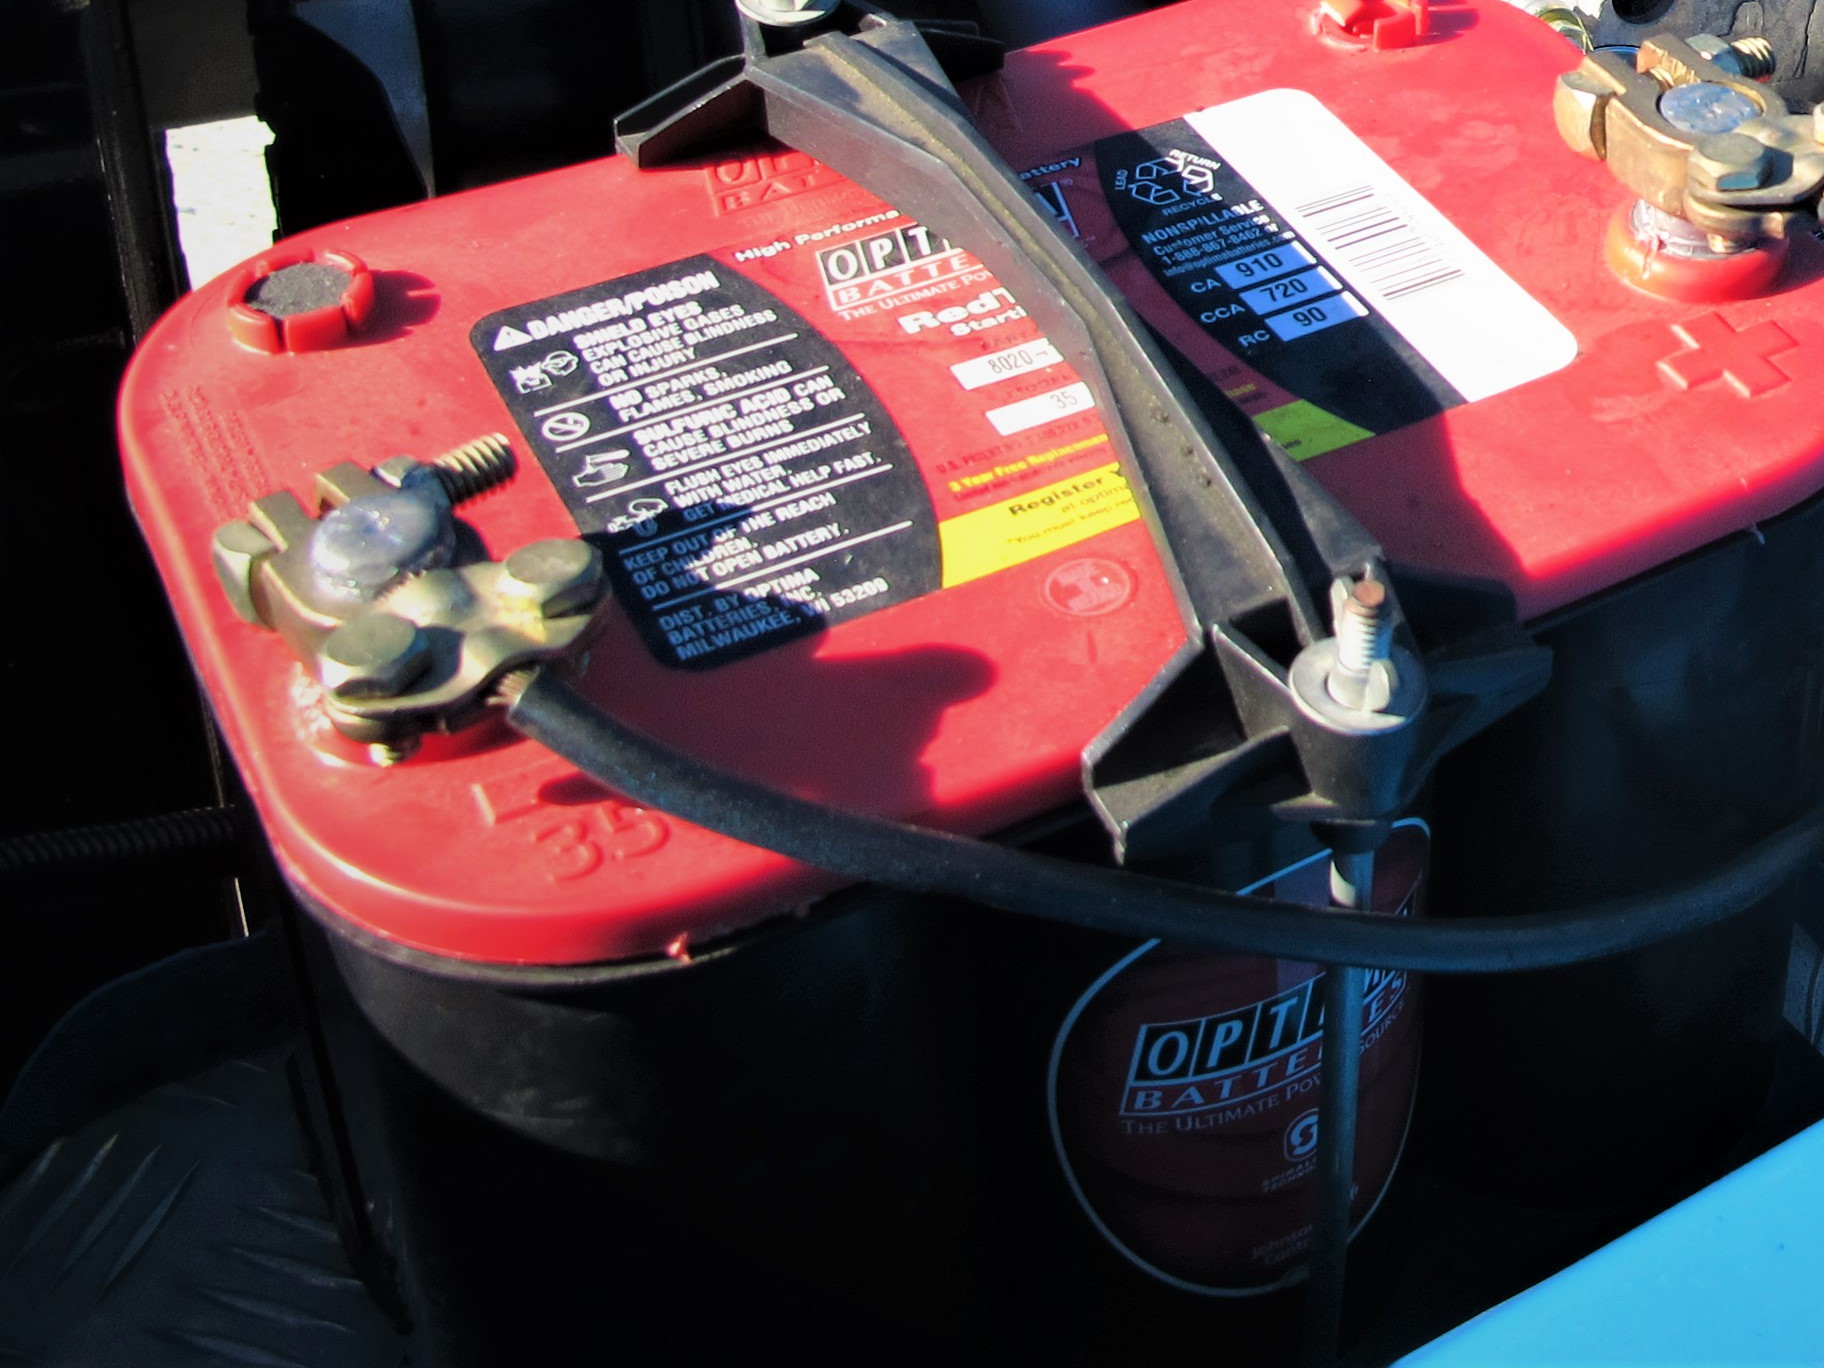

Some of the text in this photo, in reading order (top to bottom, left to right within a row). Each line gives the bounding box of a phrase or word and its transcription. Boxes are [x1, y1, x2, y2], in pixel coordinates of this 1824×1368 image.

[1020, 157, 1081, 180] attery
[1114, 169, 1128, 190] LEAD
[1168, 148, 1220, 170] RETURN
[1141, 199, 1264, 244] NONSPILLABLE
[1162, 193, 1223, 216] RECYCLE
[734, 209, 901, 263] High Performa
[827, 226, 934, 282] OPT
[1153, 214, 1271, 255] Customer Service
[838, 253, 971, 304] BATTE
[1190, 252, 1284, 294] CA 910
[526, 271, 720, 340] DANGER/POISON
[950, 305, 1027, 336] Starti
[1199, 278, 1309, 324] CCA 720
[572, 301, 703, 349] SHIELD EYES
[580, 304, 746, 362] EXPLOSIVE GASES
[589, 308, 778, 375] CAN CAUSE BLINDNESS
[1238, 306, 1328, 348] RC 90
[597, 347, 696, 387] OR INJURY
[702, 360, 793, 397] SMOKING
[608, 388, 643, 411] NO
[632, 374, 835, 445] SULFURIC ACID CAN
[1050, 391, 1078, 409] 35
[641, 387, 846, 458] CAUSE BLINDNESS OR
[651, 419, 794, 472] SEVERE BURNS
[663, 421, 872, 496] FLUSH EYES IMMEDIATELY
[673, 485, 721, 509] WITH
[684, 449, 882, 523] GET MEDICAL HELP FAST.
[1008, 477, 1103, 516] Register
[623, 492, 838, 572] KEEP OUT OF THE REACH
[632, 567, 657, 586] OF
[640, 523, 850, 601] DO NOT OPEN BATTERY.
[716, 593, 740, 612] BY
[744, 567, 820, 600] OPTIMA
[782, 585, 822, 608] INC.
[675, 609, 802, 661] MILWAUKEE,
[1175, 1095, 1280, 1132] ULTIMATE
